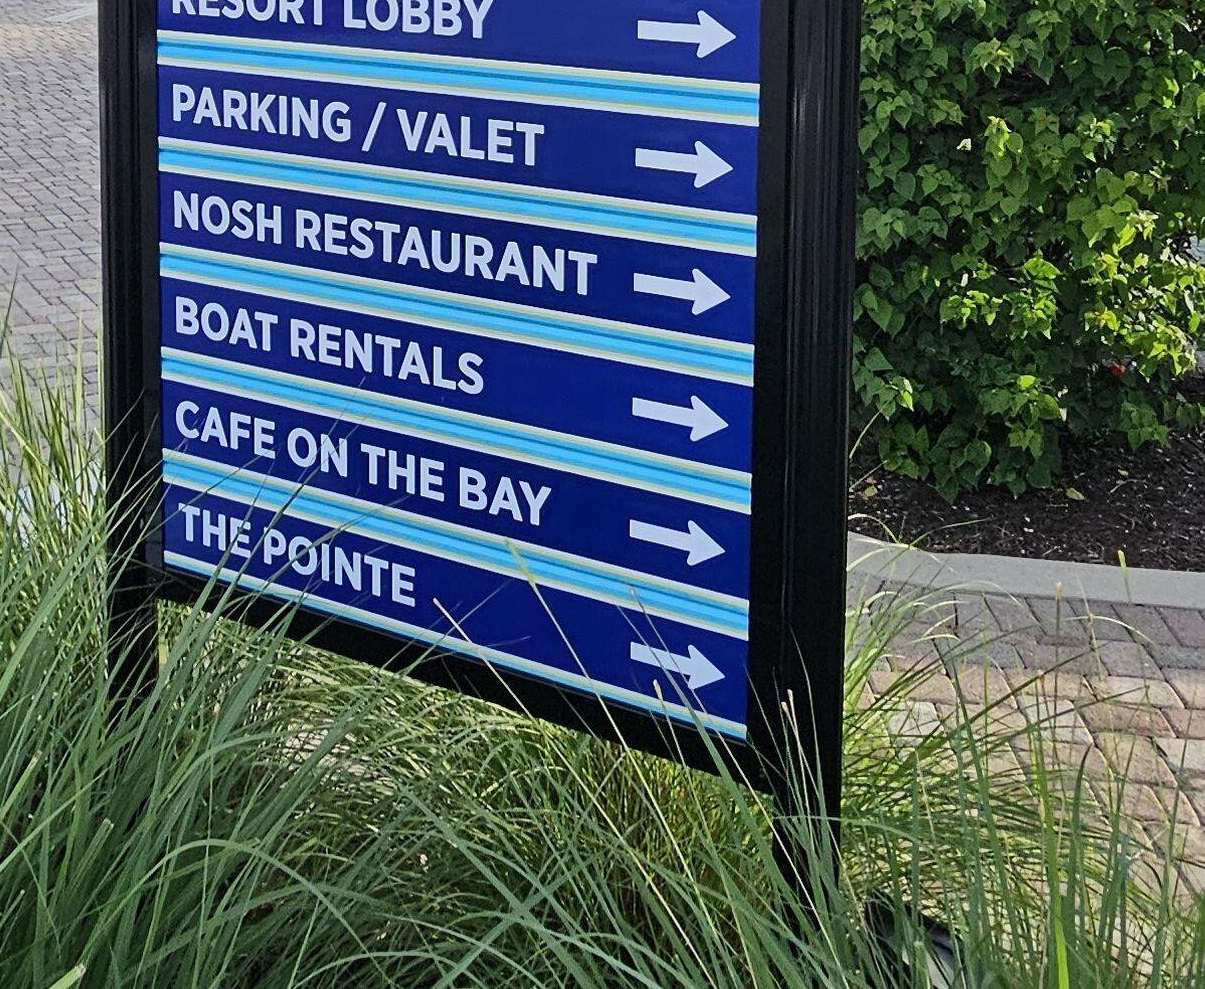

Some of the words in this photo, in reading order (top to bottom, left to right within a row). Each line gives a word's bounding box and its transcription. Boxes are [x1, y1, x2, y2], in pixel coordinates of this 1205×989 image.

[171, 83, 352, 143] PARKING
[360, 101, 388, 152] /
[396, 108, 545, 166] VALET
[172, 190, 283, 245] NOSH
[295, 209, 598, 296] RESTAURANT
[174, 296, 278, 352] BOAT
[290, 318, 485, 395] RENTALS
[174, 399, 276, 460] CAFE
[286, 427, 349, 478] ON
[360, 442, 446, 502] THE
[458, 466, 552, 527] BAY
[177, 502, 252, 557] THE
[262, 527, 416, 608] POINTE
